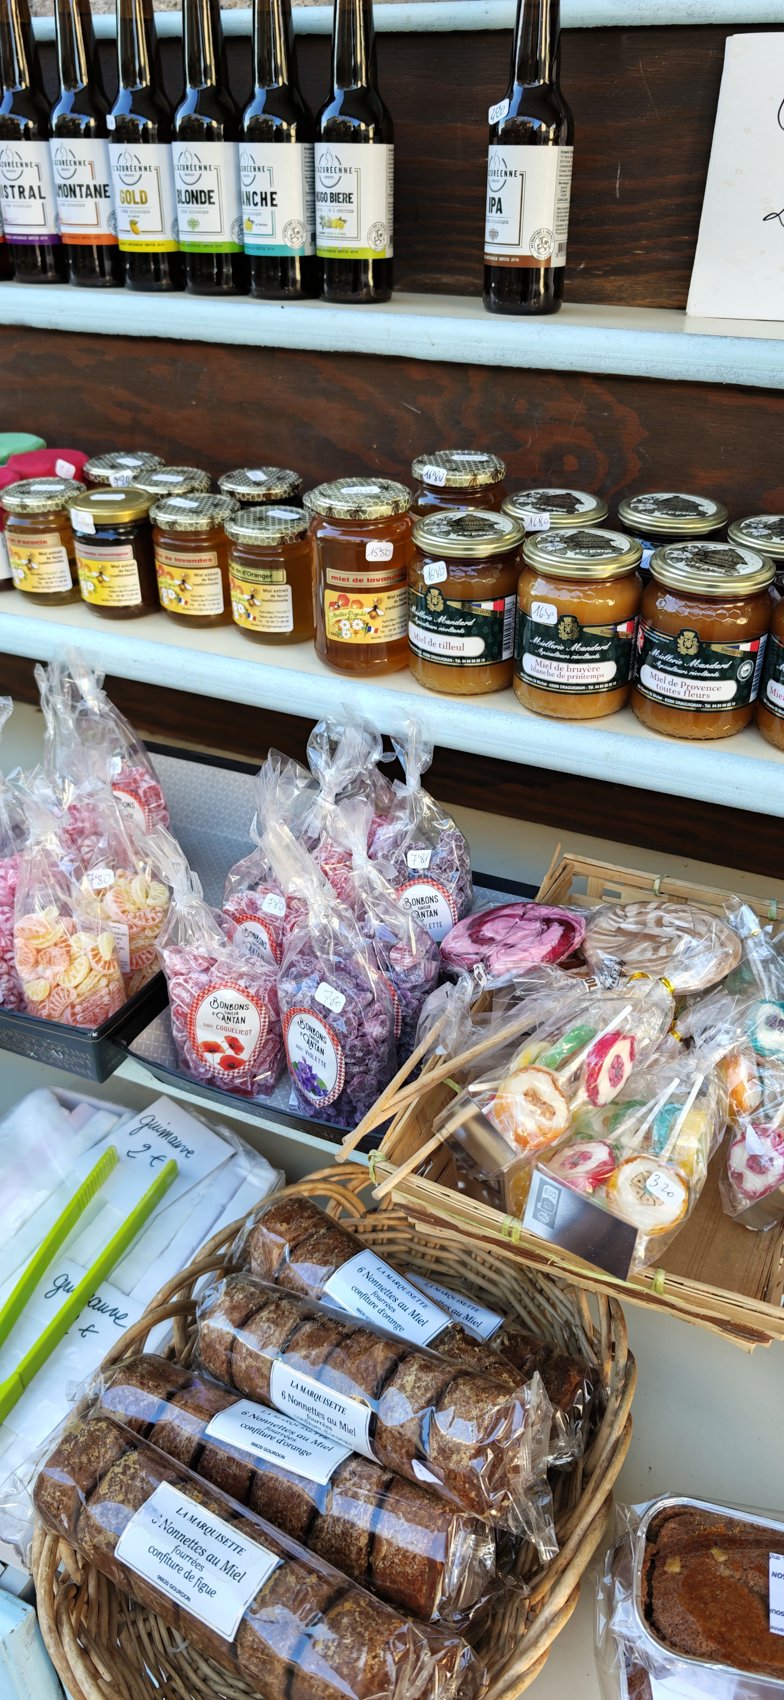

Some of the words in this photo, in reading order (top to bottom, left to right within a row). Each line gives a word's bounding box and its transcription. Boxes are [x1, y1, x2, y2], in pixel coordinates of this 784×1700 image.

[57, 183, 110, 199] MONTANE
[120, 189, 148, 205] GOLD
[177, 189, 215, 205] BLONDE
[488, 196, 503, 214] IPA
[331, 574, 350, 583] miel
[433, 615, 476, 626] Mandard
[413, 631, 426, 642] Miel
[427, 638, 437, 648] de
[439, 641, 465, 652] tilleul
[530, 635, 564, 651] Miellerie
[566, 641, 612, 652] Mandard
[535, 659, 552, 670] Miel
[554, 662, 565, 672] de
[566, 664, 601, 676] bruyère
[649, 647, 683, 665] Miellerie
[684, 659, 733, 669] Mandard
[530, 664, 555, 678] blanche
[556, 669, 566, 680] de
[566, 671, 605, 682] printemps
[649, 671, 666, 685] Miel
[667, 678, 678, 688] de
[680, 681, 722, 692] Provence
[655, 682, 681, 696] toutes
[683, 686, 711, 699] fleurs
[424, 921, 443, 930] LETTE
[209, 996, 250, 1011] BONBONS
[215, 1024, 253, 1036] COQUELICOT
[297, 1017, 327, 1045] BONBONS
[126, 1143, 152, 1158] 2
[150, 1154, 167, 1167] €
[376, 1266, 386, 1275] LA
[386, 1273, 429, 1310] MARQUISETTE
[351, 1285, 378, 1310] confiture
[377, 1308, 405, 1333] d'orange
[362, 1271, 399, 1303] Nonnettes
[397, 1301, 410, 1312] au
[408, 1309, 429, 1327] Miel
[370, 1290, 397, 1313] fourrées
[451, 1308, 463, 1317] au
[462, 1313, 483, 1328] Miel
[290, 1380, 299, 1390] LA
[299, 1385, 348, 1415] MARQUISETTE
[281, 1390, 286, 1400] 6
[287, 1393, 326, 1421] Nonnettes
[326, 1416, 338, 1428] au
[339, 1420, 357, 1438] Miel
[240, 1422, 276, 1440] confiture
[276, 1439, 312, 1457] d'orange
[248, 1413, 295, 1436] Nonnettes
[296, 1433, 310, 1442] au
[310, 1439, 335, 1452] Miel
[264, 1426, 296, 1442] fourrées
[263, 1447, 286, 1460] GOURDON
[175, 1507, 189, 1519] LA
[187, 1514, 247, 1556] MARQUISETTE
[158, 1518, 207, 1557] Nonnettes
[205, 1553, 221, 1567] au
[220, 1560, 247, 1583] Miel
[170, 1544, 205, 1572] fourrées
[147, 1545, 184, 1575] confiture
[183, 1569, 196, 1583] de
[192, 1577, 217, 1598] figue
